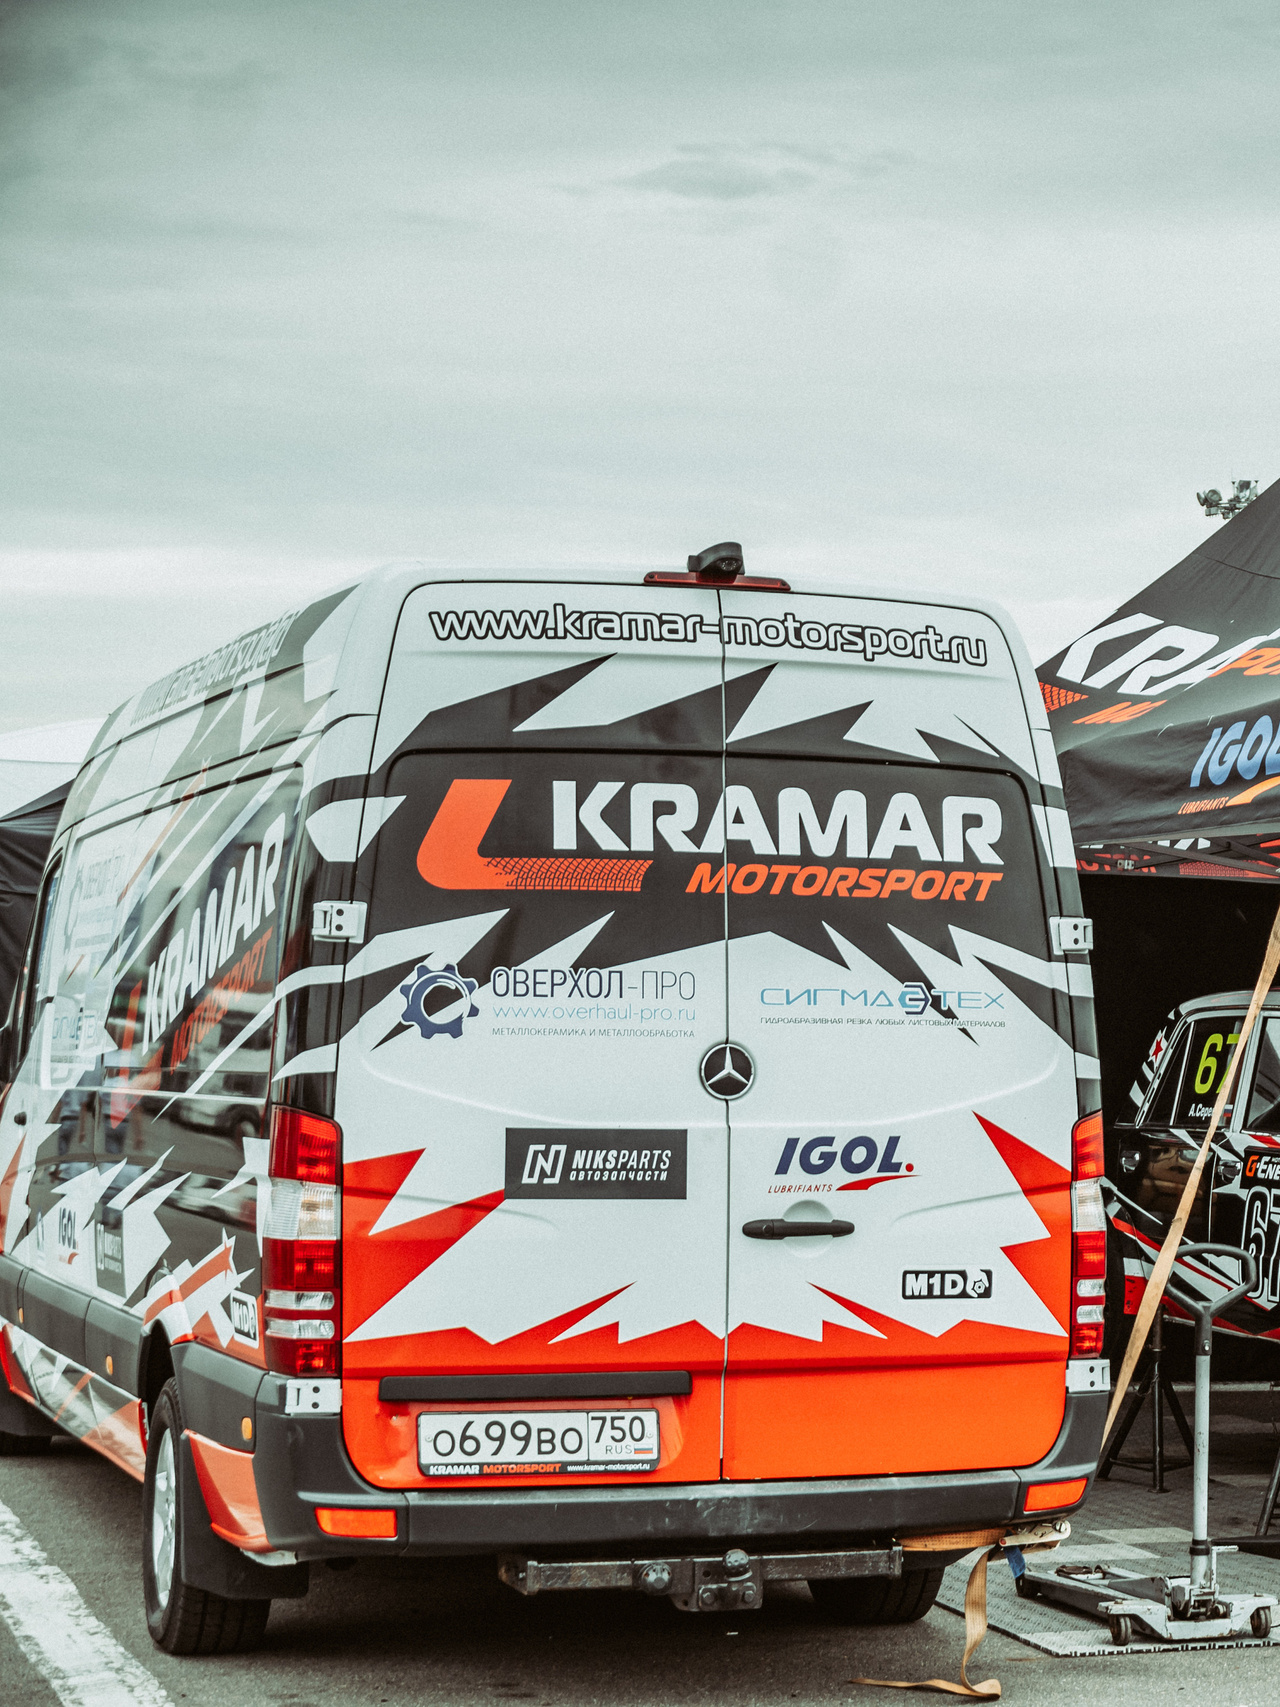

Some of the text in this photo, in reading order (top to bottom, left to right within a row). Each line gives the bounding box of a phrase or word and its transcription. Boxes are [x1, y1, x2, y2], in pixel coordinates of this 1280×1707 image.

[428, 603, 989, 666] www.kramar-motorsport.ru
[552, 780, 1004, 865] KRAMAR
[685, 862, 1004, 902] MOTORSPORT
[141, 811, 286, 1057] KRAMAR
[492, 968, 696, 1001] ОВЕРХОЛ-ПРО
[492, 1004, 696, 1023] www.overhaul-pro.ru
[760, 1017, 843, 1025] ГИДРОАБРАЗИВНАЯ
[875, 1018, 905, 1026] ЛЮБЫХ
[907, 1018, 951, 1026] ЛИСТОВЫХ
[492, 1027, 695, 1038] МЕТАЛЛОКЕРАМИКА И МЕТАЛЛООБРАБОТКА
[572, 1150, 672, 1170] NIKSPARTS
[569, 1170, 668, 1181] автозапчасти
[768, 1184, 832, 1194] LUBRIFIANTS
[590, 1416, 646, 1443] 750
[605, 1444, 633, 1454] RUS
[429, 1462, 651, 1475] KRAMAR MOTORSPORT www.kramar-motorsport.ru
